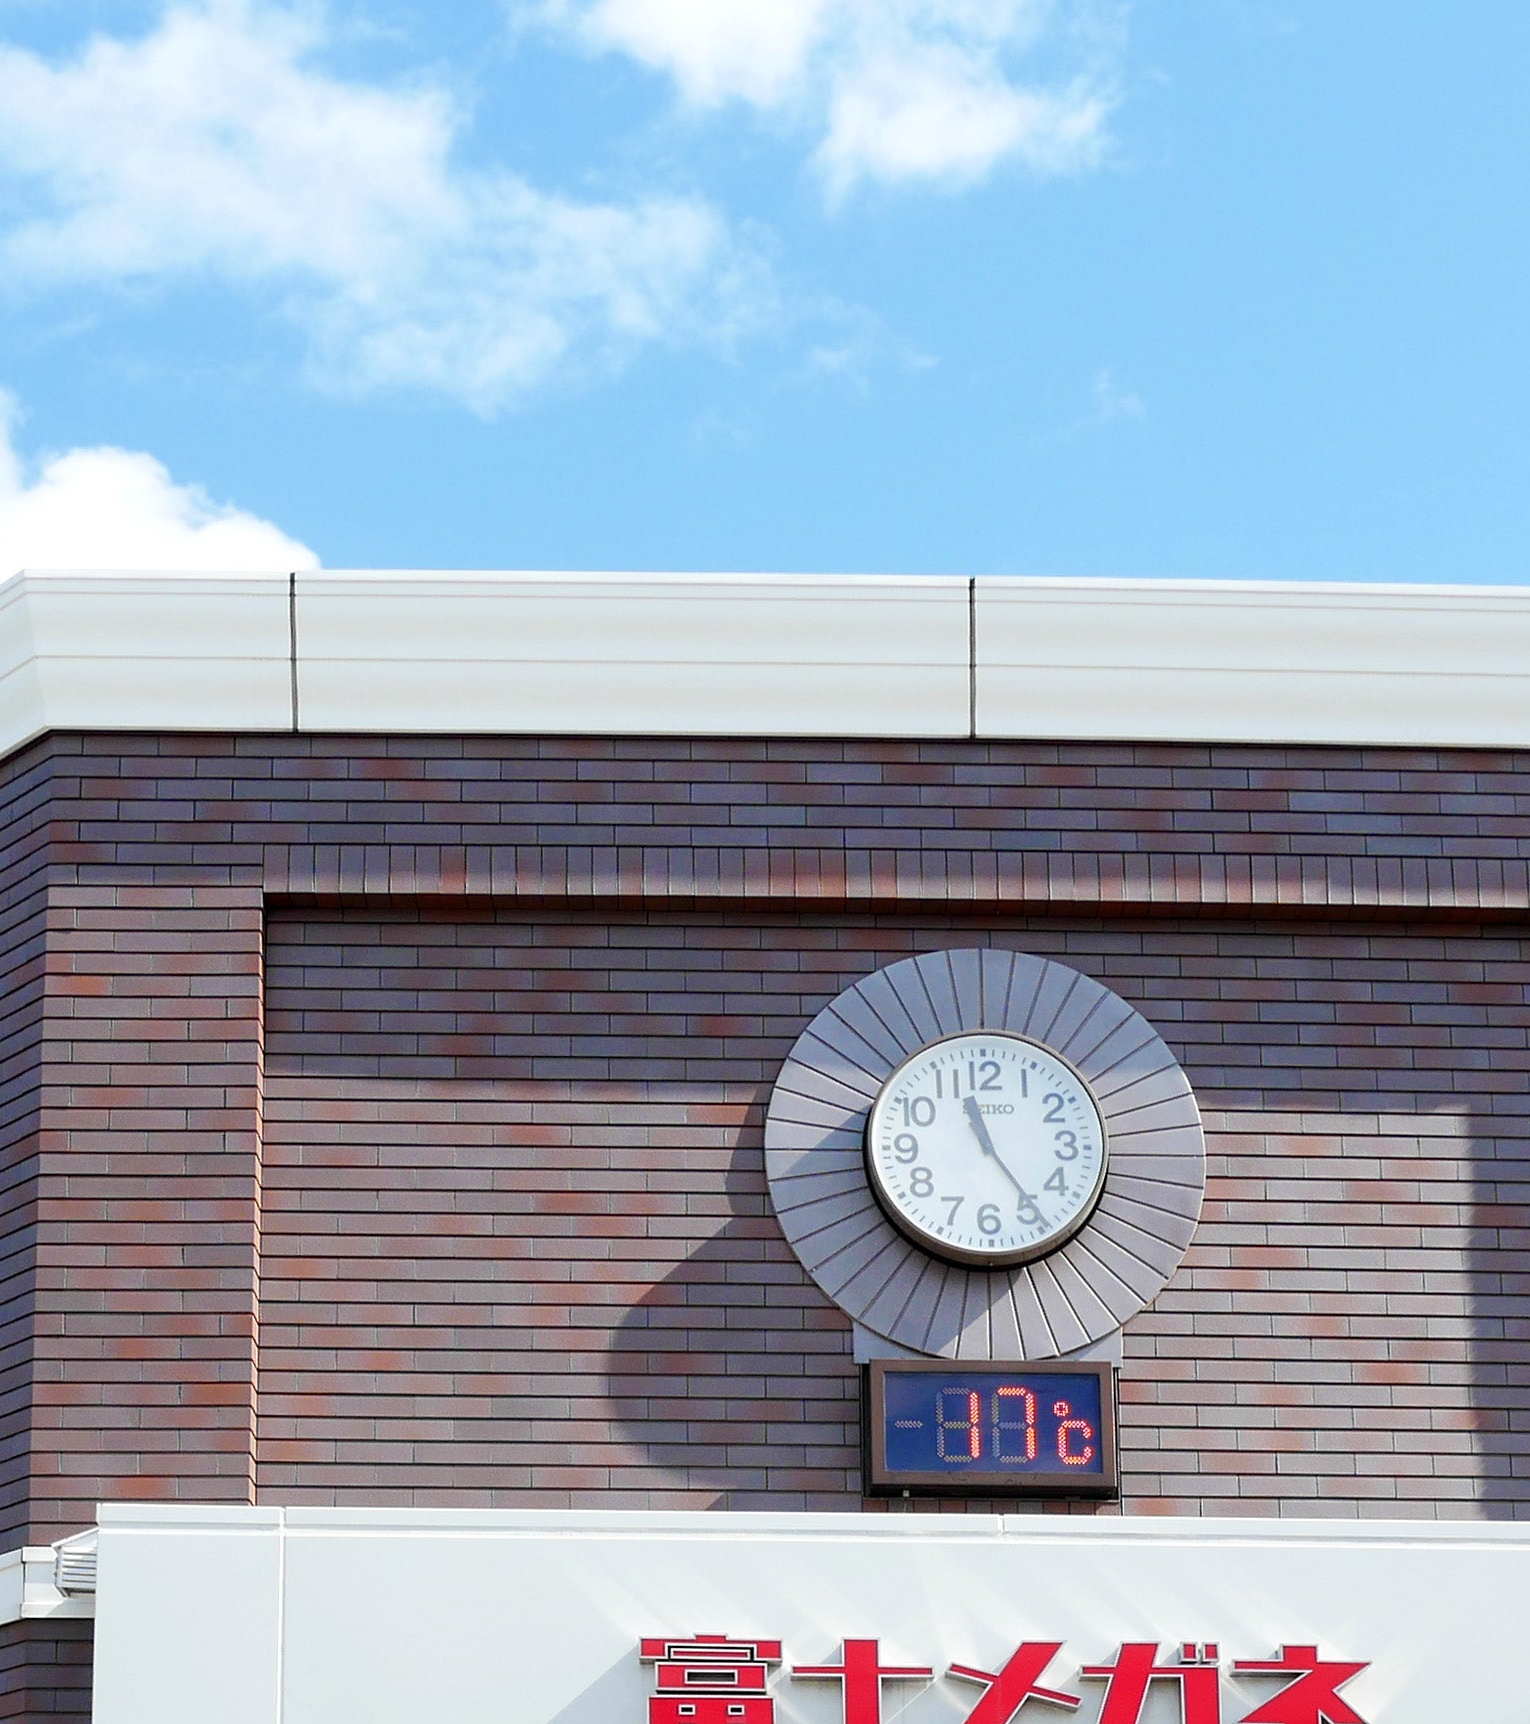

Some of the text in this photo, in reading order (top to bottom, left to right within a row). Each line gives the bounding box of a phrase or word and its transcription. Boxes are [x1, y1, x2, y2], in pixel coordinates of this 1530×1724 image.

[935, 1069, 960, 1099] 11
[968, 1060, 1002, 1091] 12
[1020, 1068, 1028, 1098] 1
[903, 1095, 936, 1127] 10
[1042, 1092, 1066, 1123] 2
[894, 1133, 919, 1164] 9
[1053, 1130, 1079, 1161] 3
[909, 1166, 934, 1198] 8
[1043, 1166, 1069, 1197] 4
[940, 1196, 965, 1226] 7
[976, 1203, 1002, 1235] 6
[1016, 1194, 1039, 1226] 5
